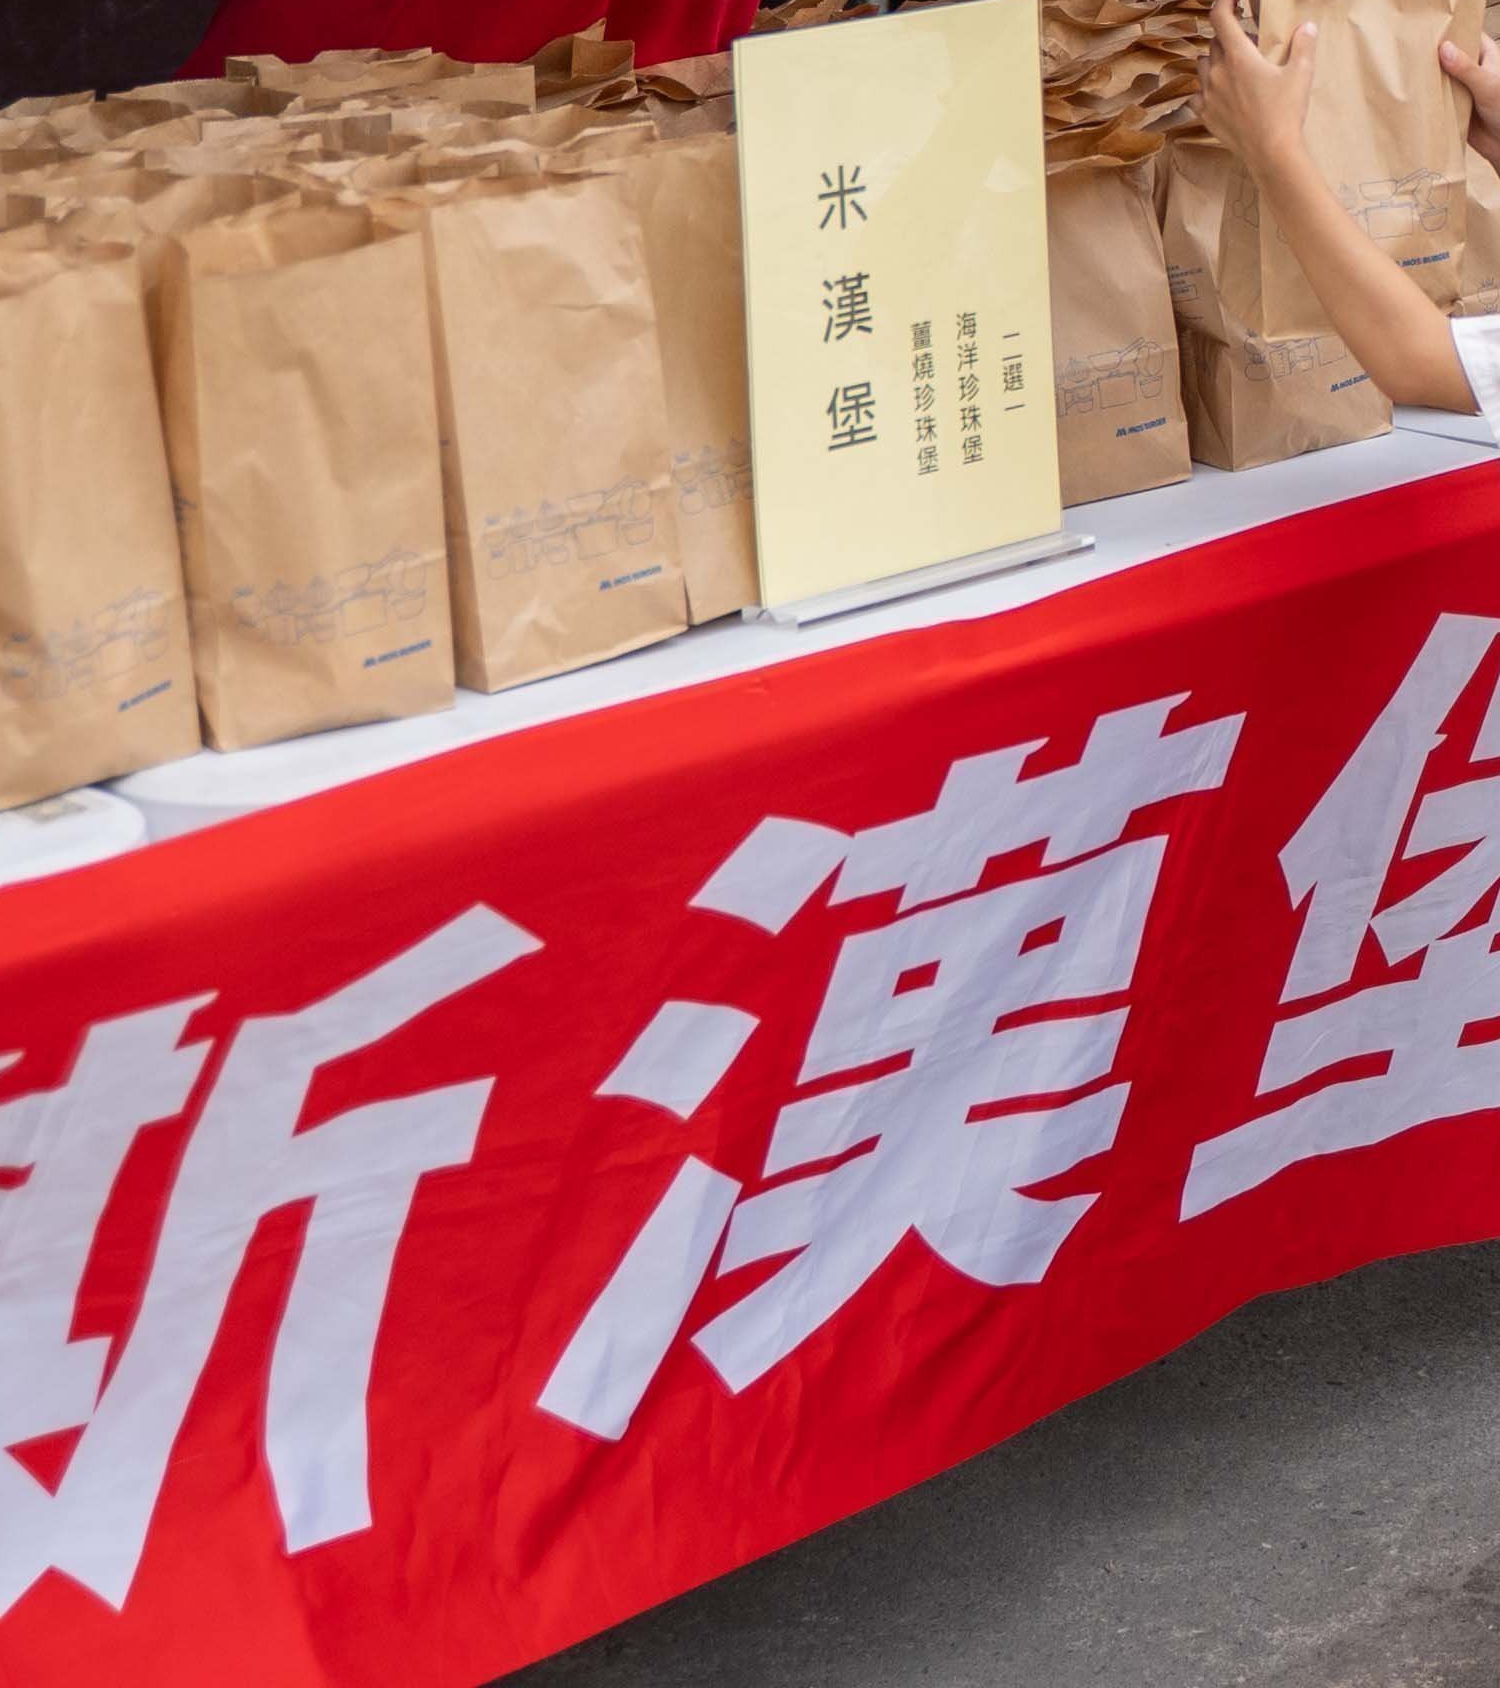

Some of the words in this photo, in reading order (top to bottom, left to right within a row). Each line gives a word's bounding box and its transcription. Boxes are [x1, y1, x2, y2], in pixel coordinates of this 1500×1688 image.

[955, 311, 984, 466] 海洋珍珠堡
